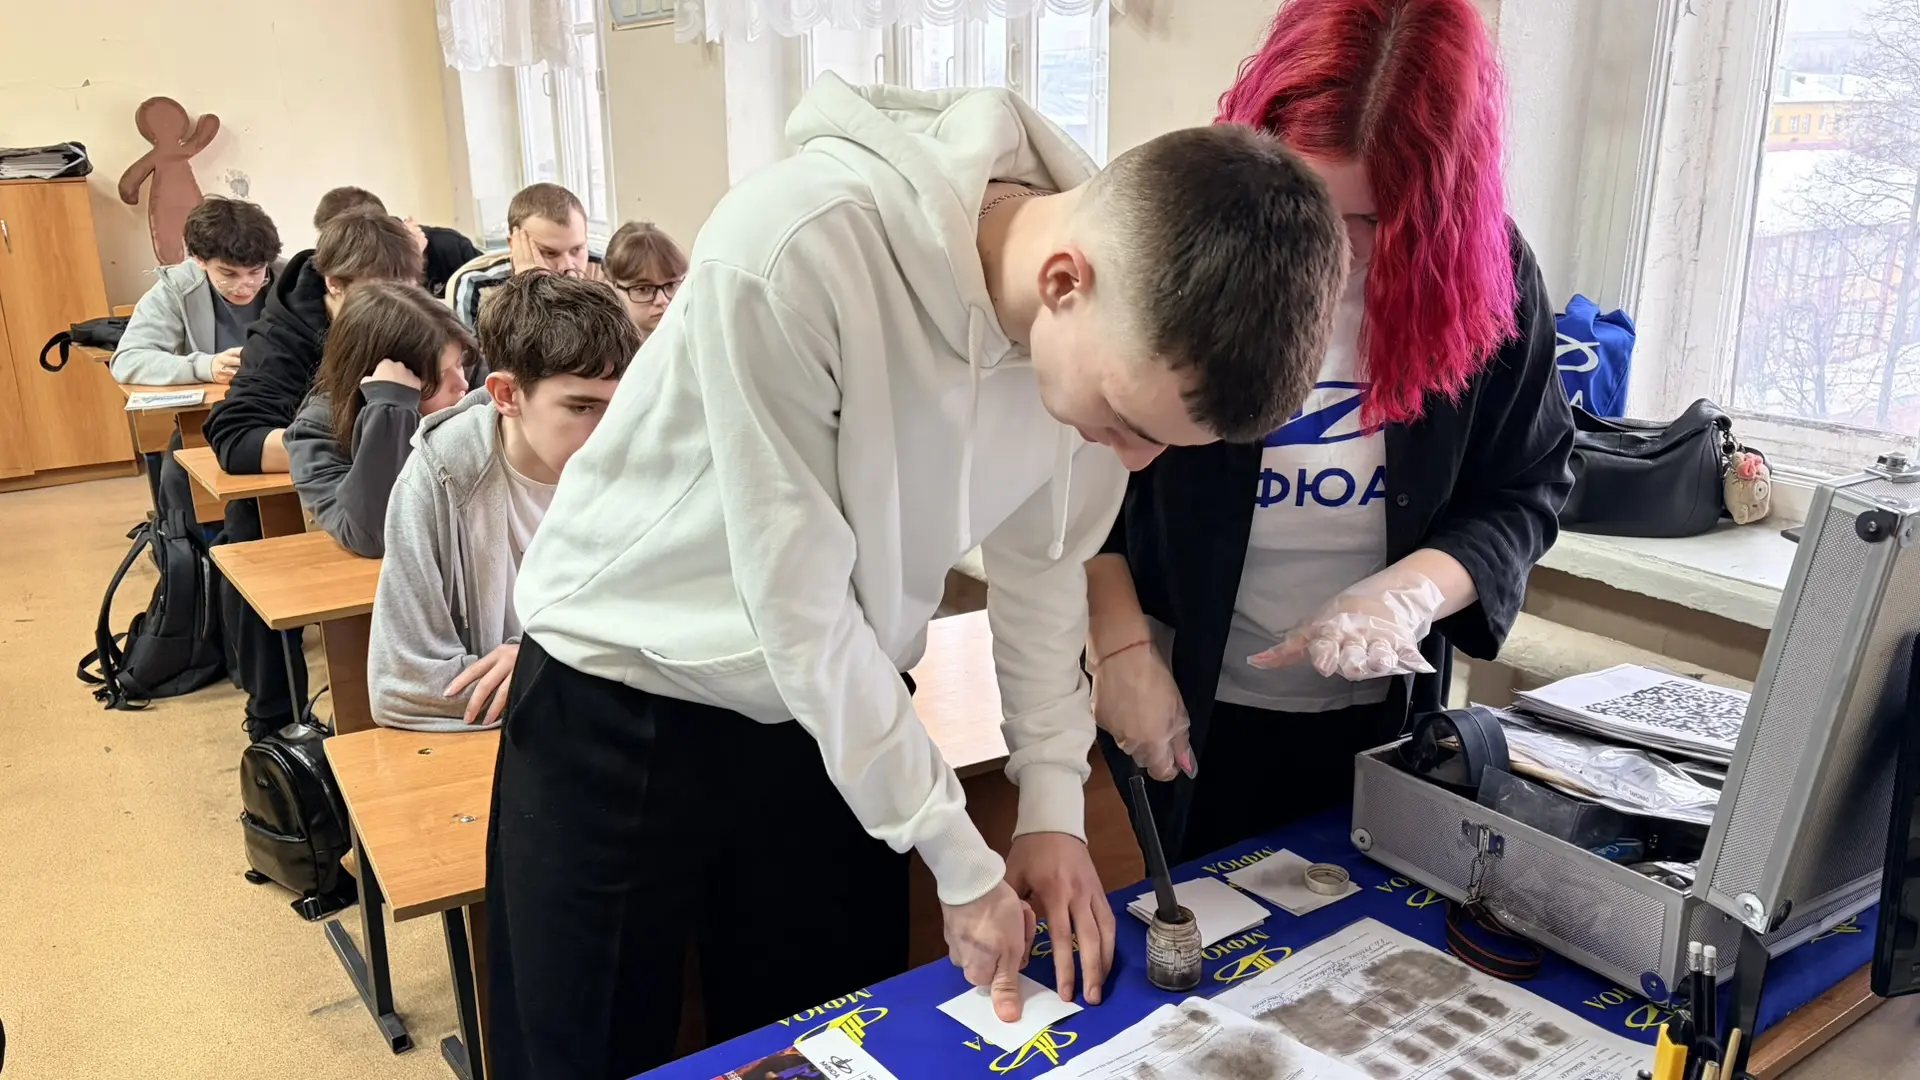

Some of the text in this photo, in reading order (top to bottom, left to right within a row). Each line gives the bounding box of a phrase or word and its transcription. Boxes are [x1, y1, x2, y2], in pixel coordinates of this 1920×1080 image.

[1255, 466, 1386, 508] ФЮА
[1201, 929, 1271, 961] МФЮ
[777, 987, 873, 1027] МФЮА
[1582, 987, 1633, 1010] ЮА
